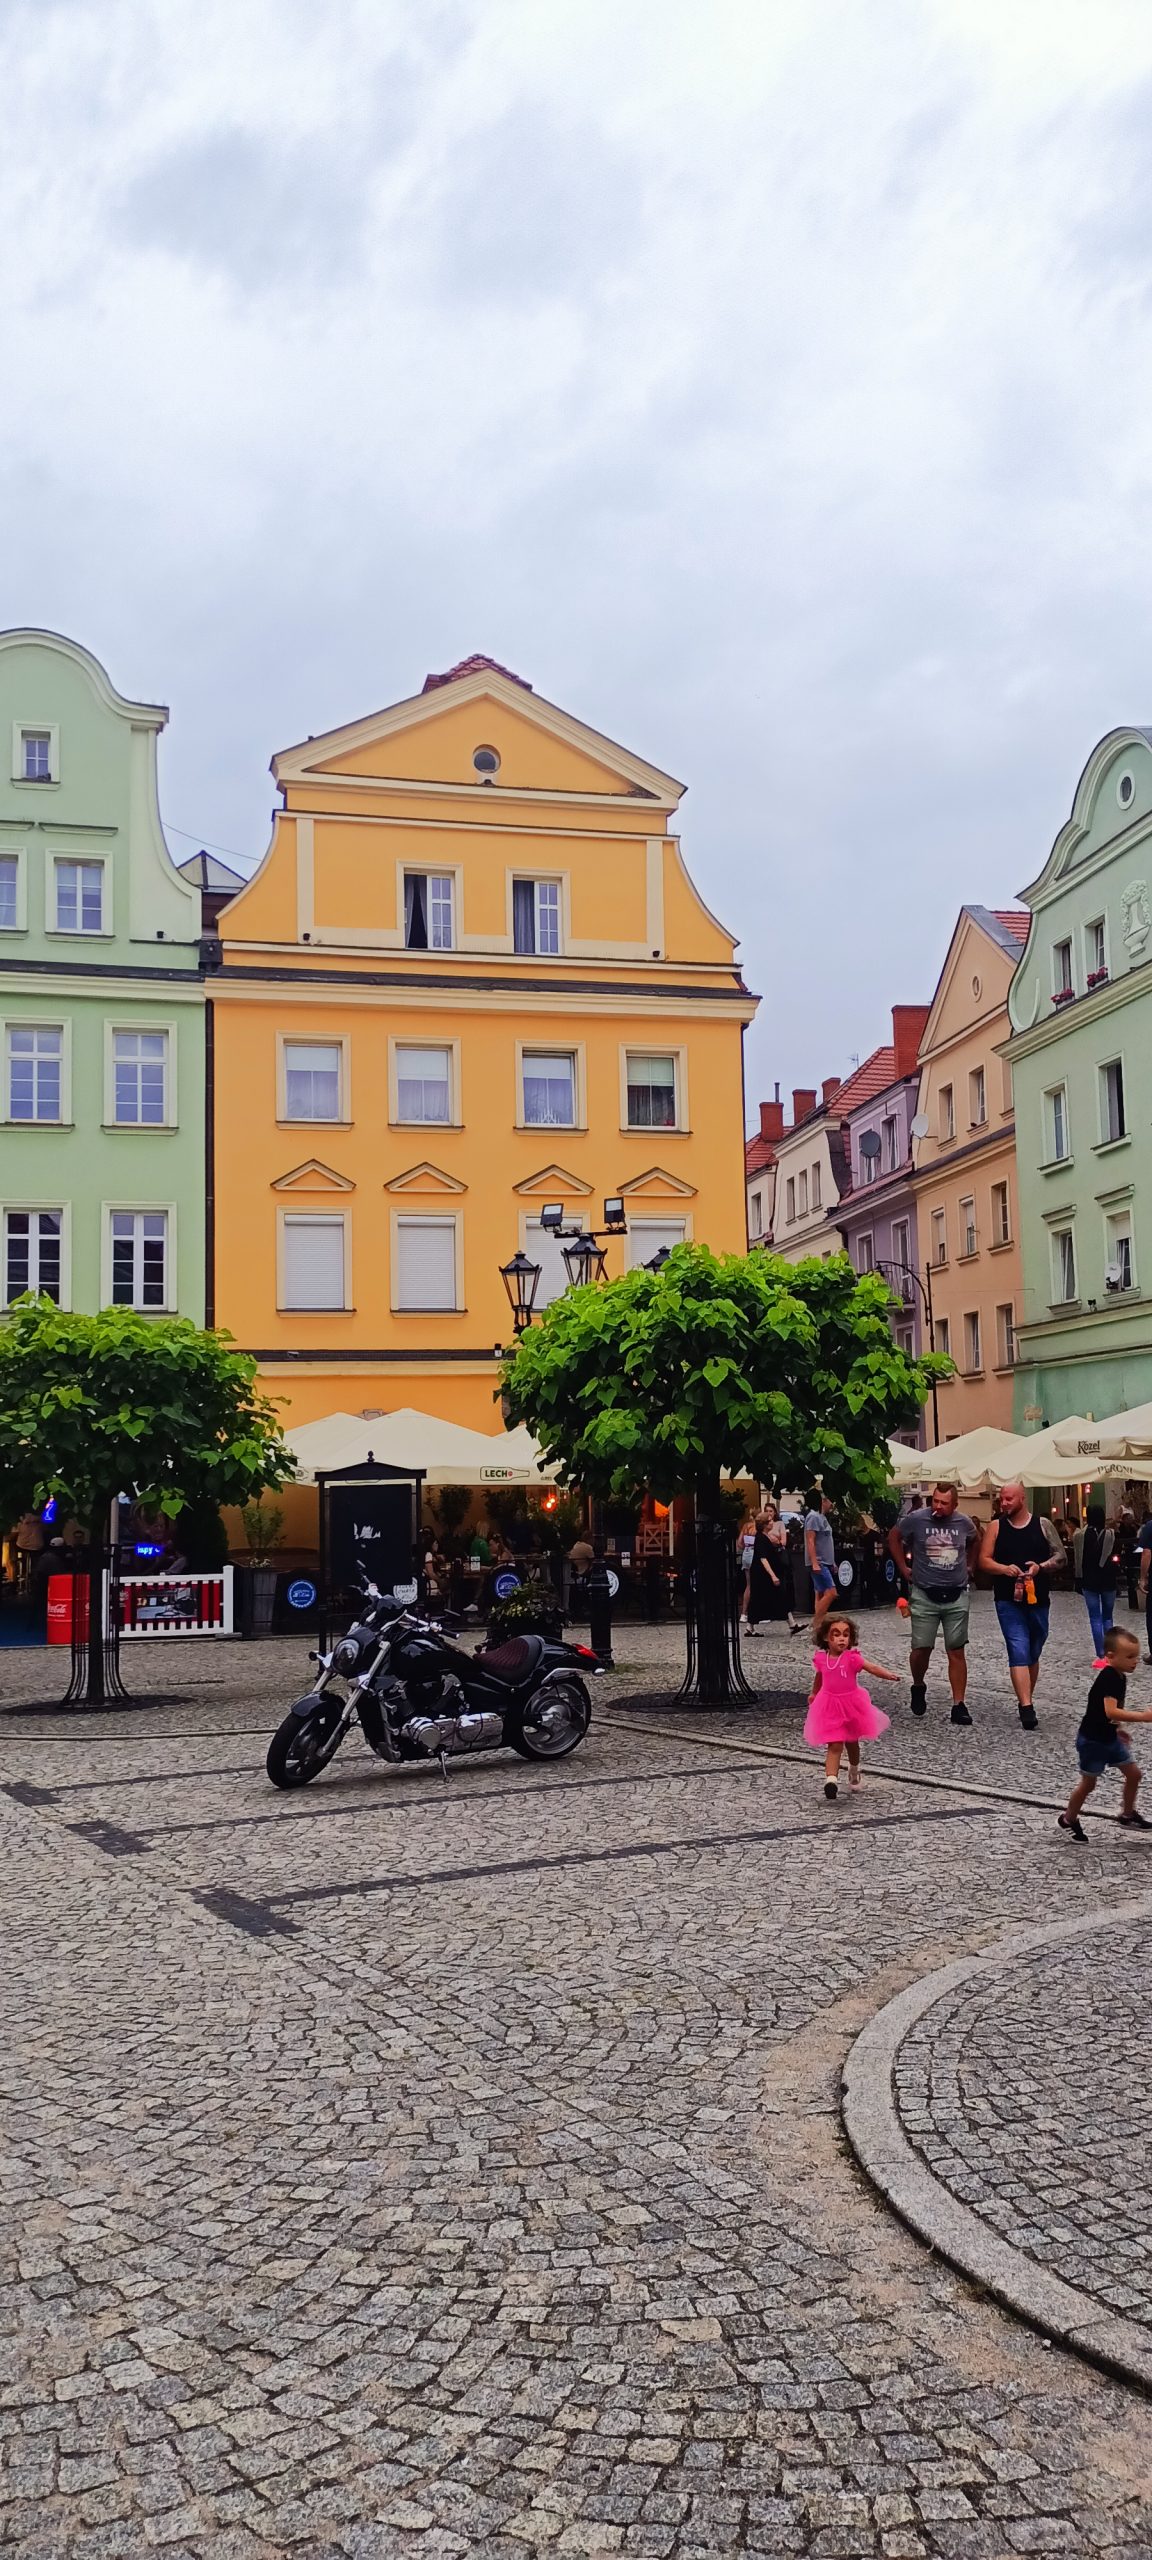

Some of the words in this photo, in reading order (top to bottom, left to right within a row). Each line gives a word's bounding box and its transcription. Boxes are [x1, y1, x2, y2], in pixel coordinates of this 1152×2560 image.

[1077, 1440, 1101, 1454] Kozel
[485, 1469, 508, 1478] LECH
[1097, 1464, 1133, 1474] PERONI
